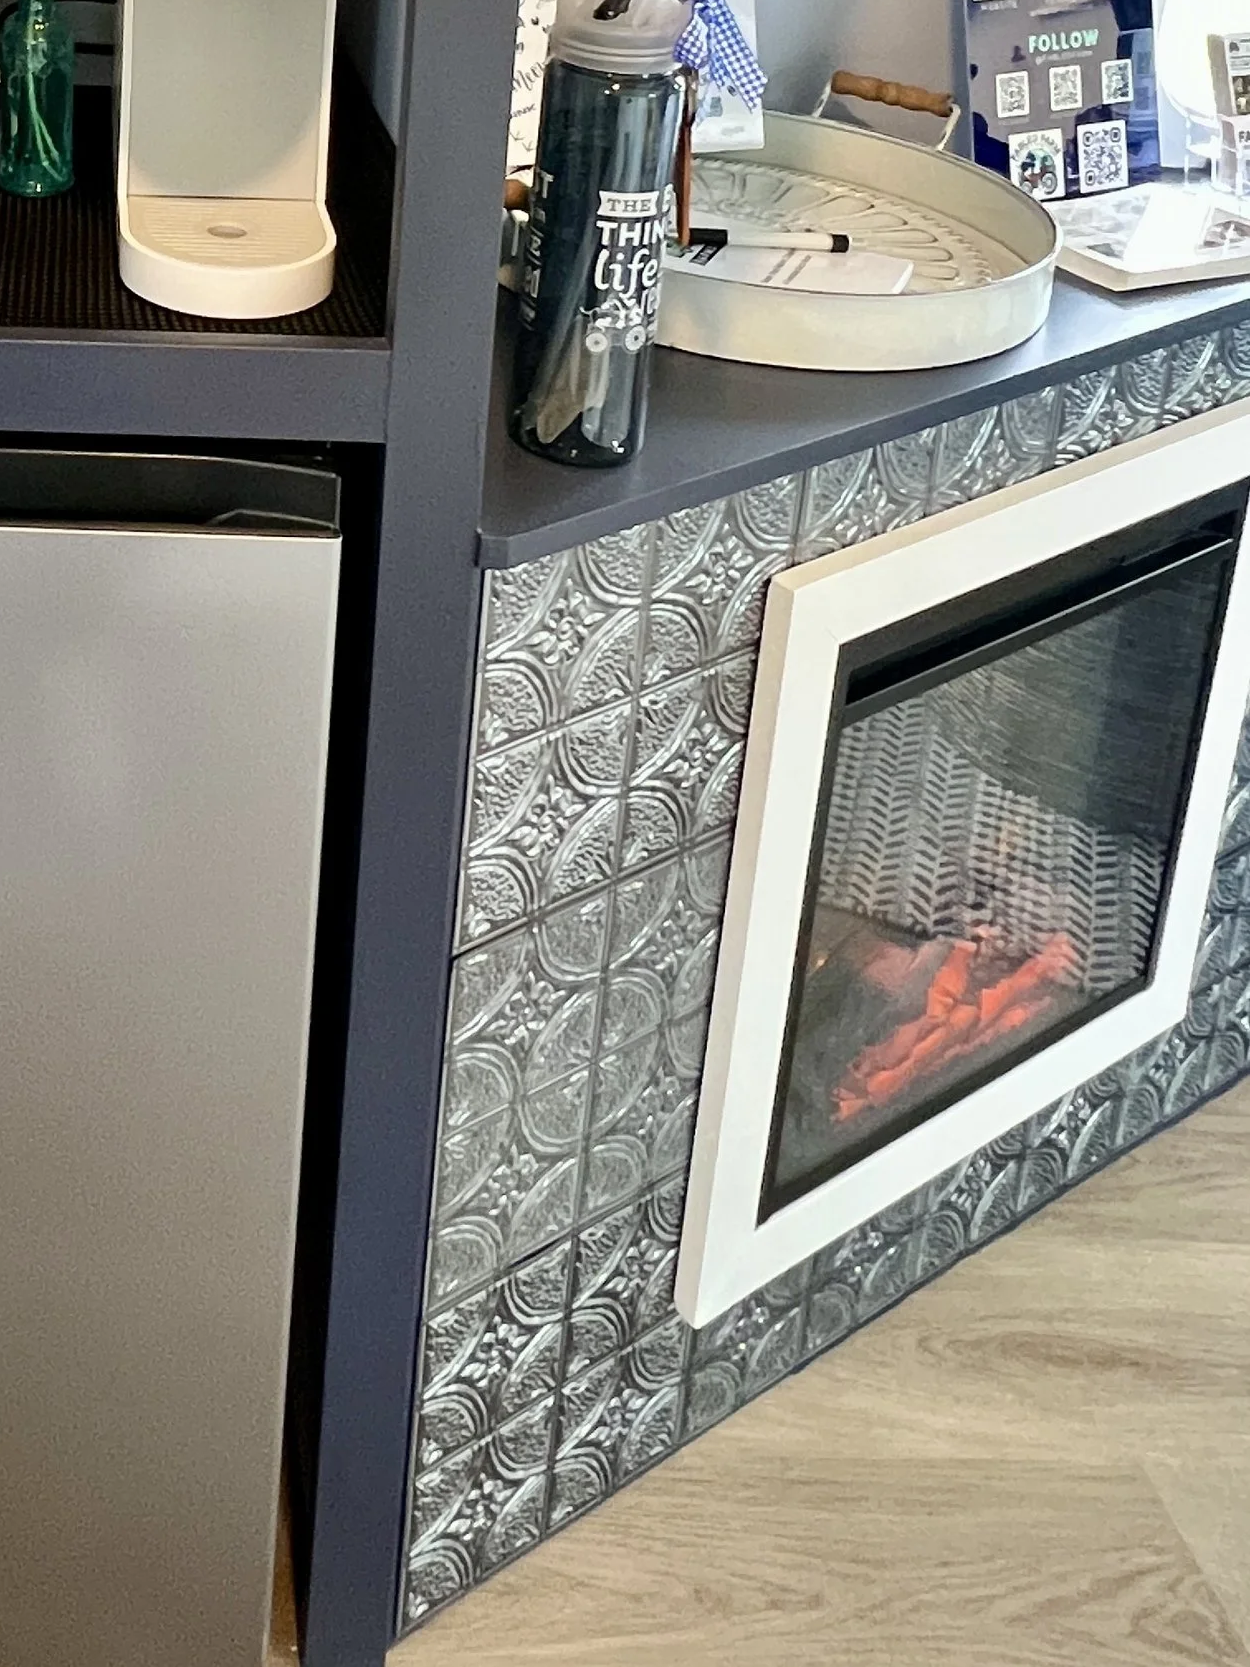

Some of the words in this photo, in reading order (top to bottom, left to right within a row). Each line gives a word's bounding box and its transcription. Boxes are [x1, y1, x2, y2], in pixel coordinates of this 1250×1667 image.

[1027, 28, 1100, 54] FOLLOW
[606, 197, 652, 213] THE
[593, 247, 659, 299] life
